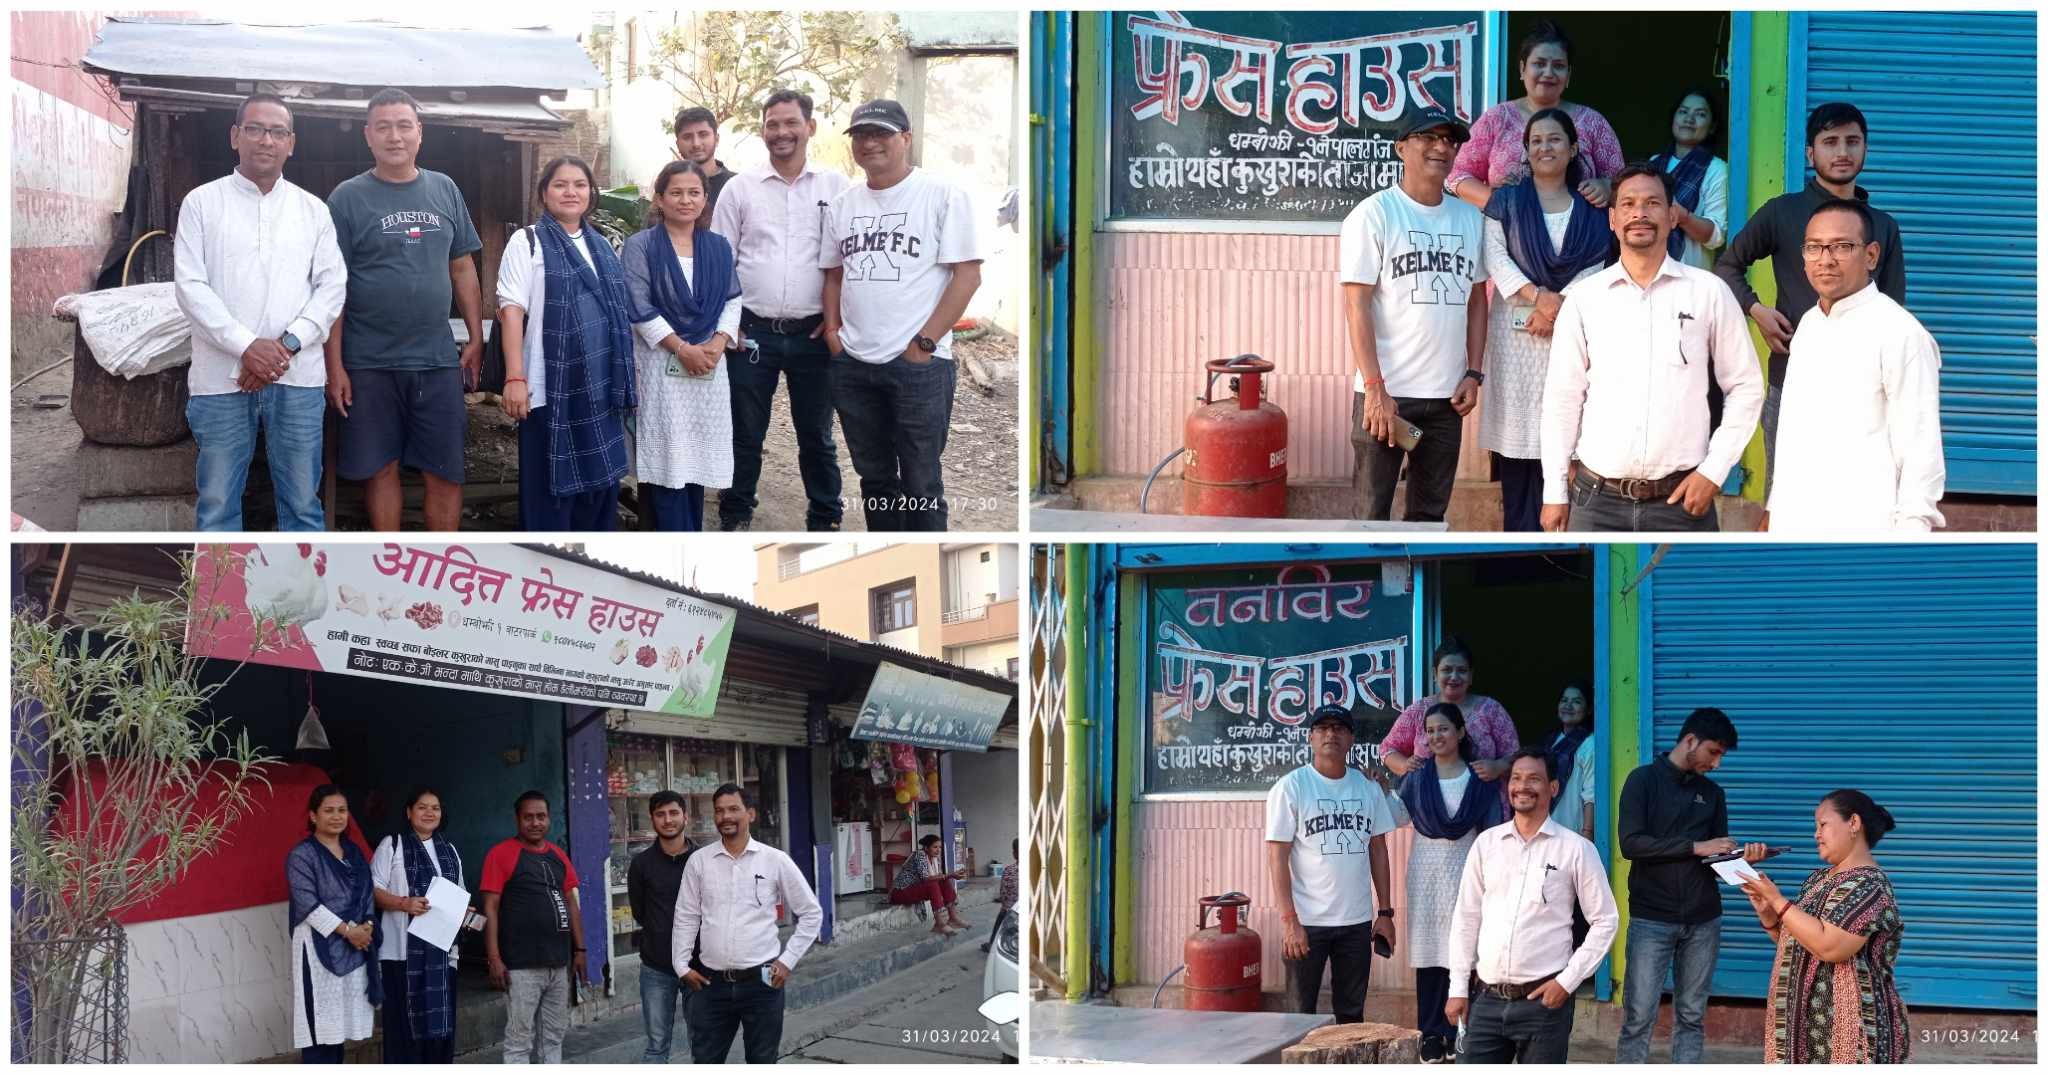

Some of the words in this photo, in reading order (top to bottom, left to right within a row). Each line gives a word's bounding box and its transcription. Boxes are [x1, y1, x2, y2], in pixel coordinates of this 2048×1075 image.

[1286, 21, 1478, 134] हाउस
[1185, 147, 1233, 189] यहाँ
[381, 211, 441, 230] HOUSTON
[1391, 250, 1453, 280] KELME
[521, 567, 584, 621] फ्रेस
[587, 596, 665, 637] हाउस
[1157, 621, 1266, 722] फ्रेस
[1268, 635, 1409, 725] हाउस
[1305, 813, 1353, 837] KELME
[551, 890, 569, 928] ICEBERG
